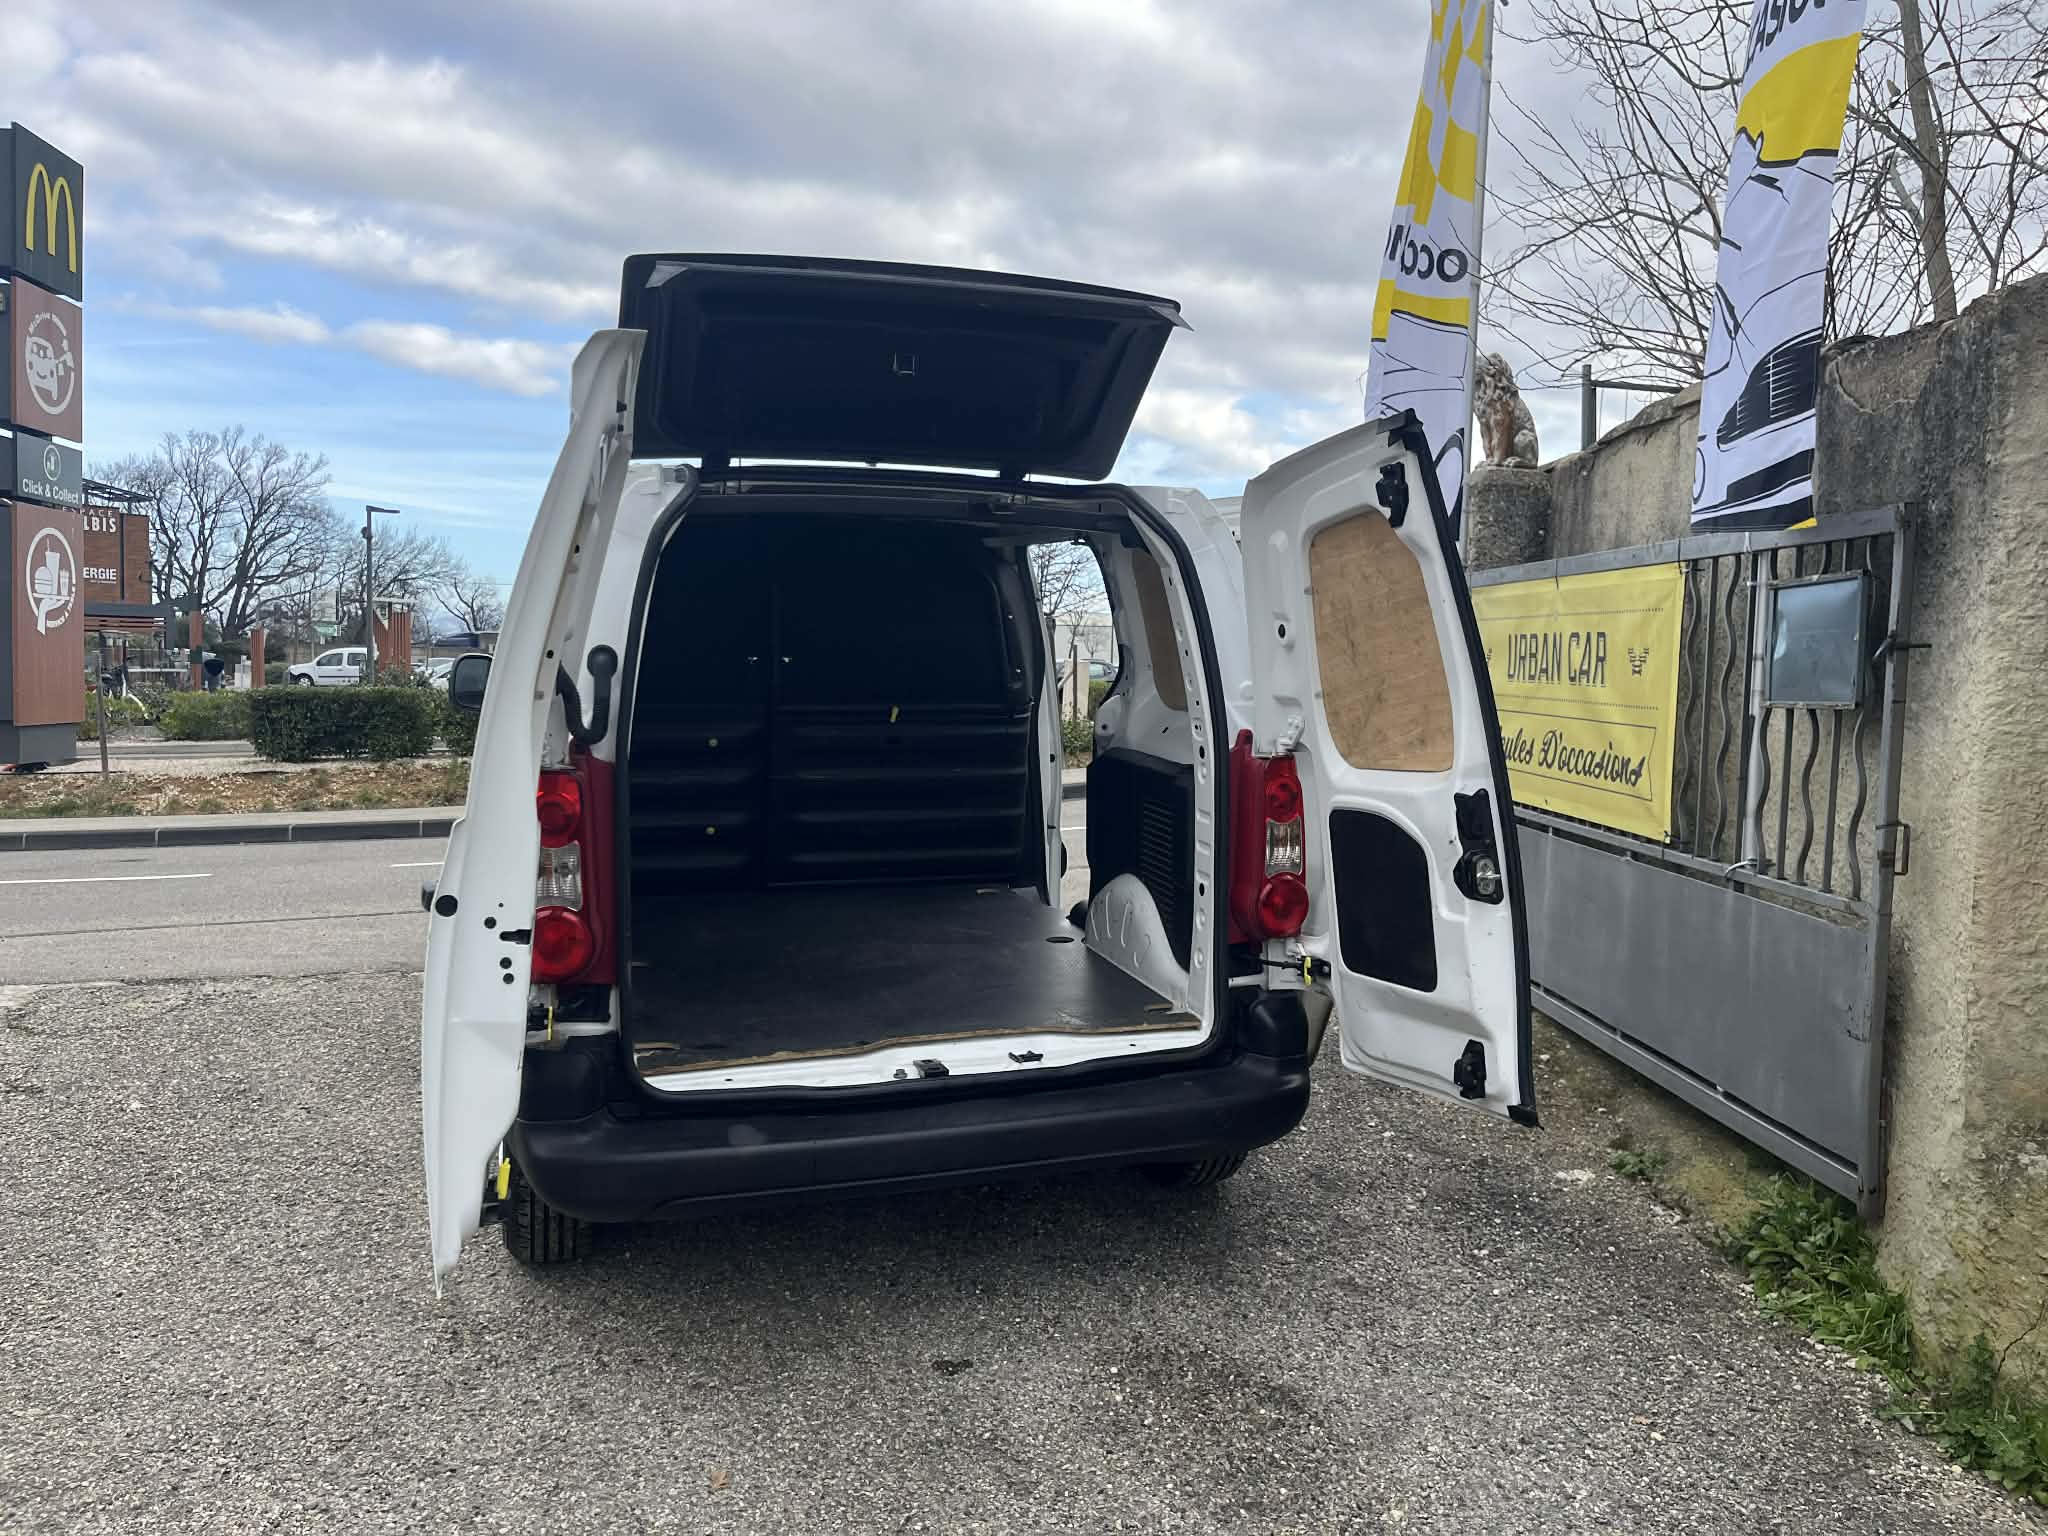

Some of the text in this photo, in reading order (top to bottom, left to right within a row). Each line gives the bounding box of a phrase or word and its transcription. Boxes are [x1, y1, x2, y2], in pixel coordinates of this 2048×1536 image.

[22, 478, 79, 504] Click & Collect
[1507, 631, 1607, 687] URBAN CAR
[1538, 729, 1645, 787] D'occasions
